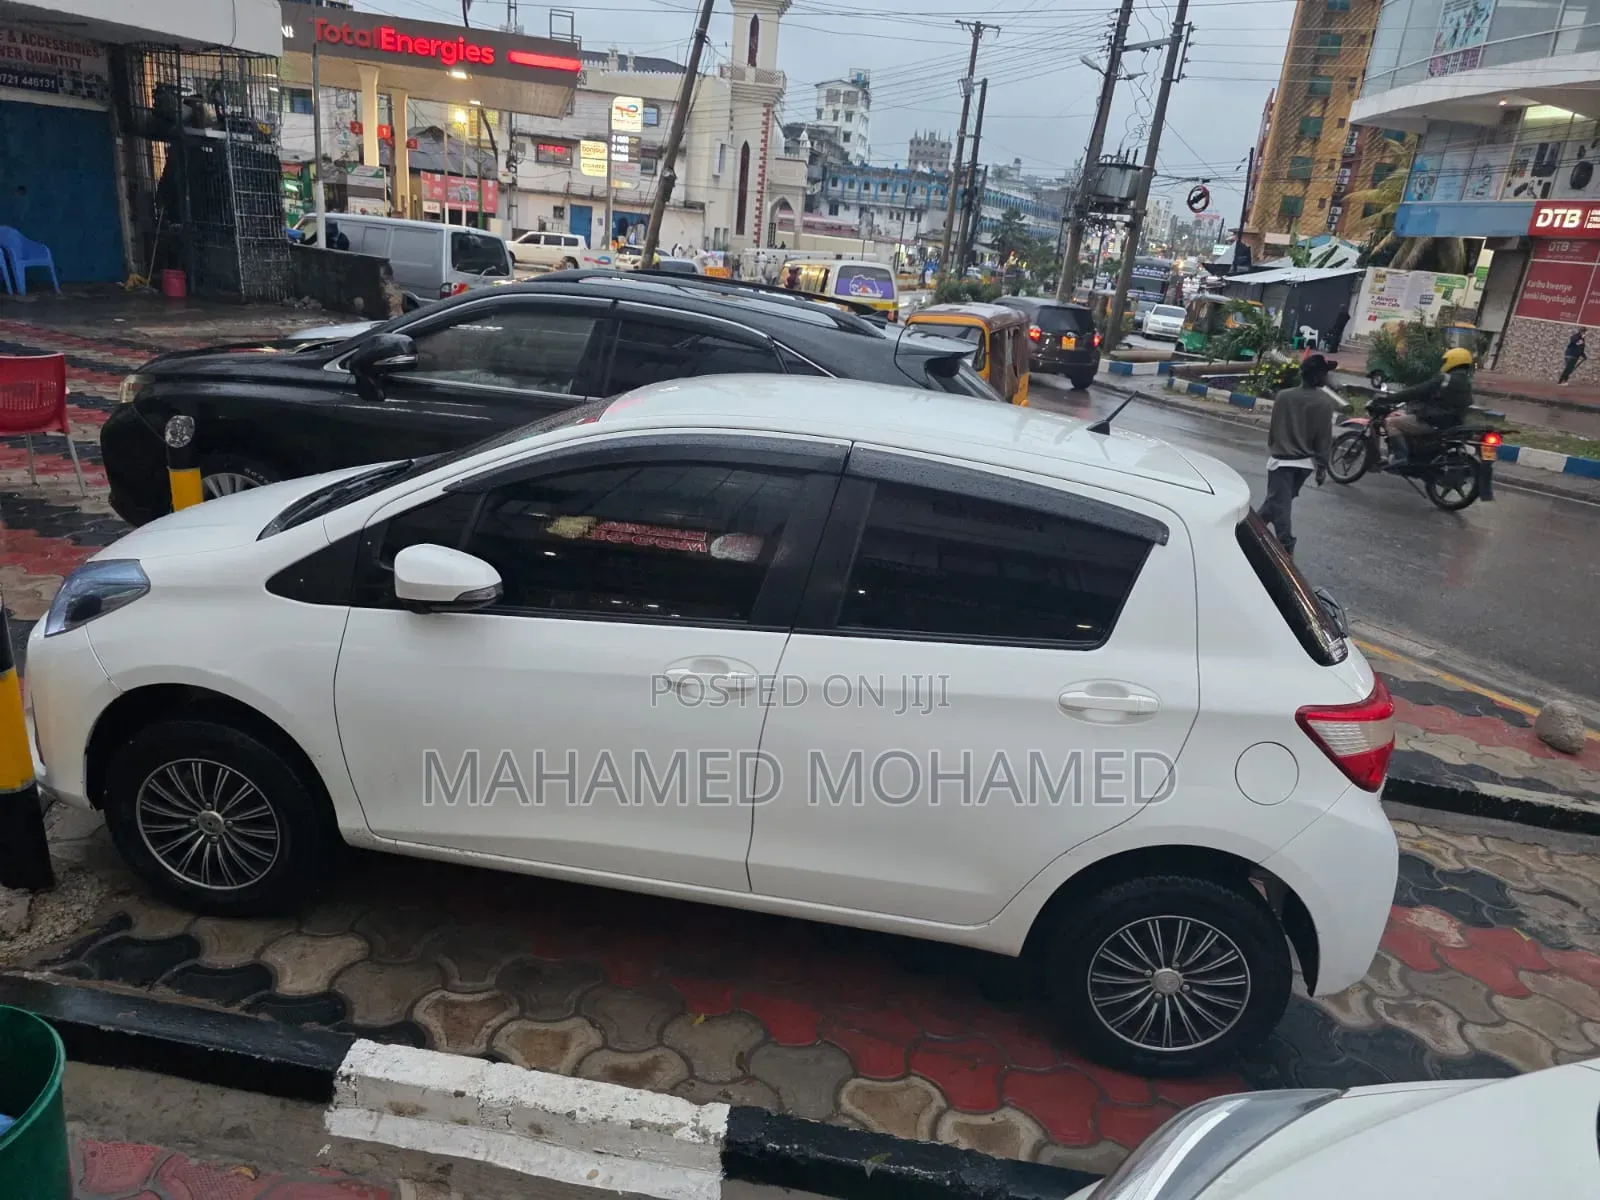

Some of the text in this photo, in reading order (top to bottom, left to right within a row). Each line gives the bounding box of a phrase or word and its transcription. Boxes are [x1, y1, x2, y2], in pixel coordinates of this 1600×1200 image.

[21, 32, 101, 58] ACCESSORIES
[309, 17, 495, 66] TotalEnergies
[25, 47, 81, 69] QUANTITY
[0, 73, 18, 84] 721
[1536, 208, 1582, 228] DTB
[1548, 241, 1570, 251] DTB
